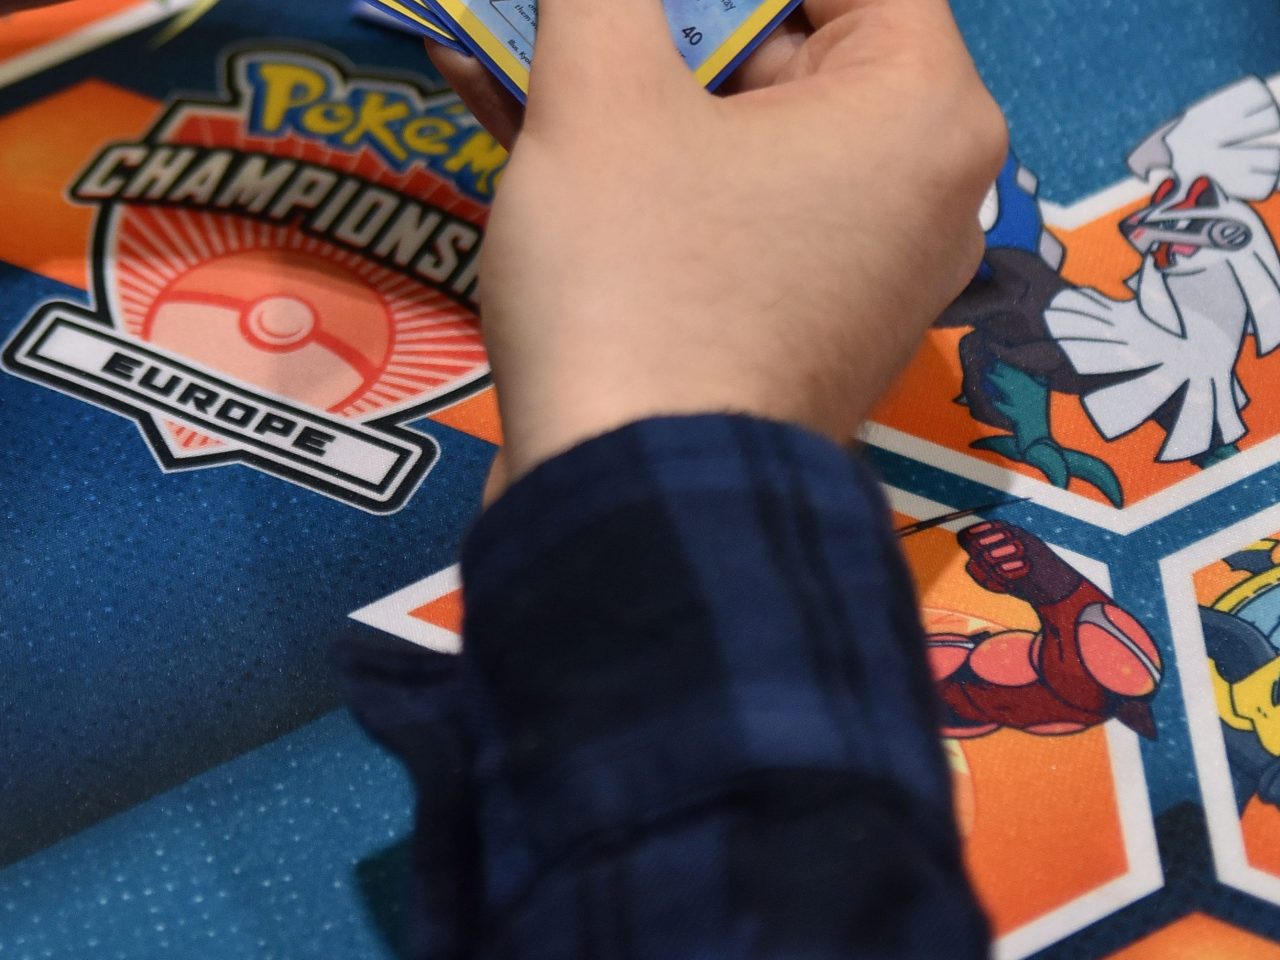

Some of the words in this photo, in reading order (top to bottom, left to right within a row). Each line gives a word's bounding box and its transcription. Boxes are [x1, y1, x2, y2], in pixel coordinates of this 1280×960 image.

[682, 26, 703, 46] 40
[255, 61, 508, 194] Pokém
[77, 144, 482, 295] CHAMPIONS
[101, 350, 337, 458] EUROPE
